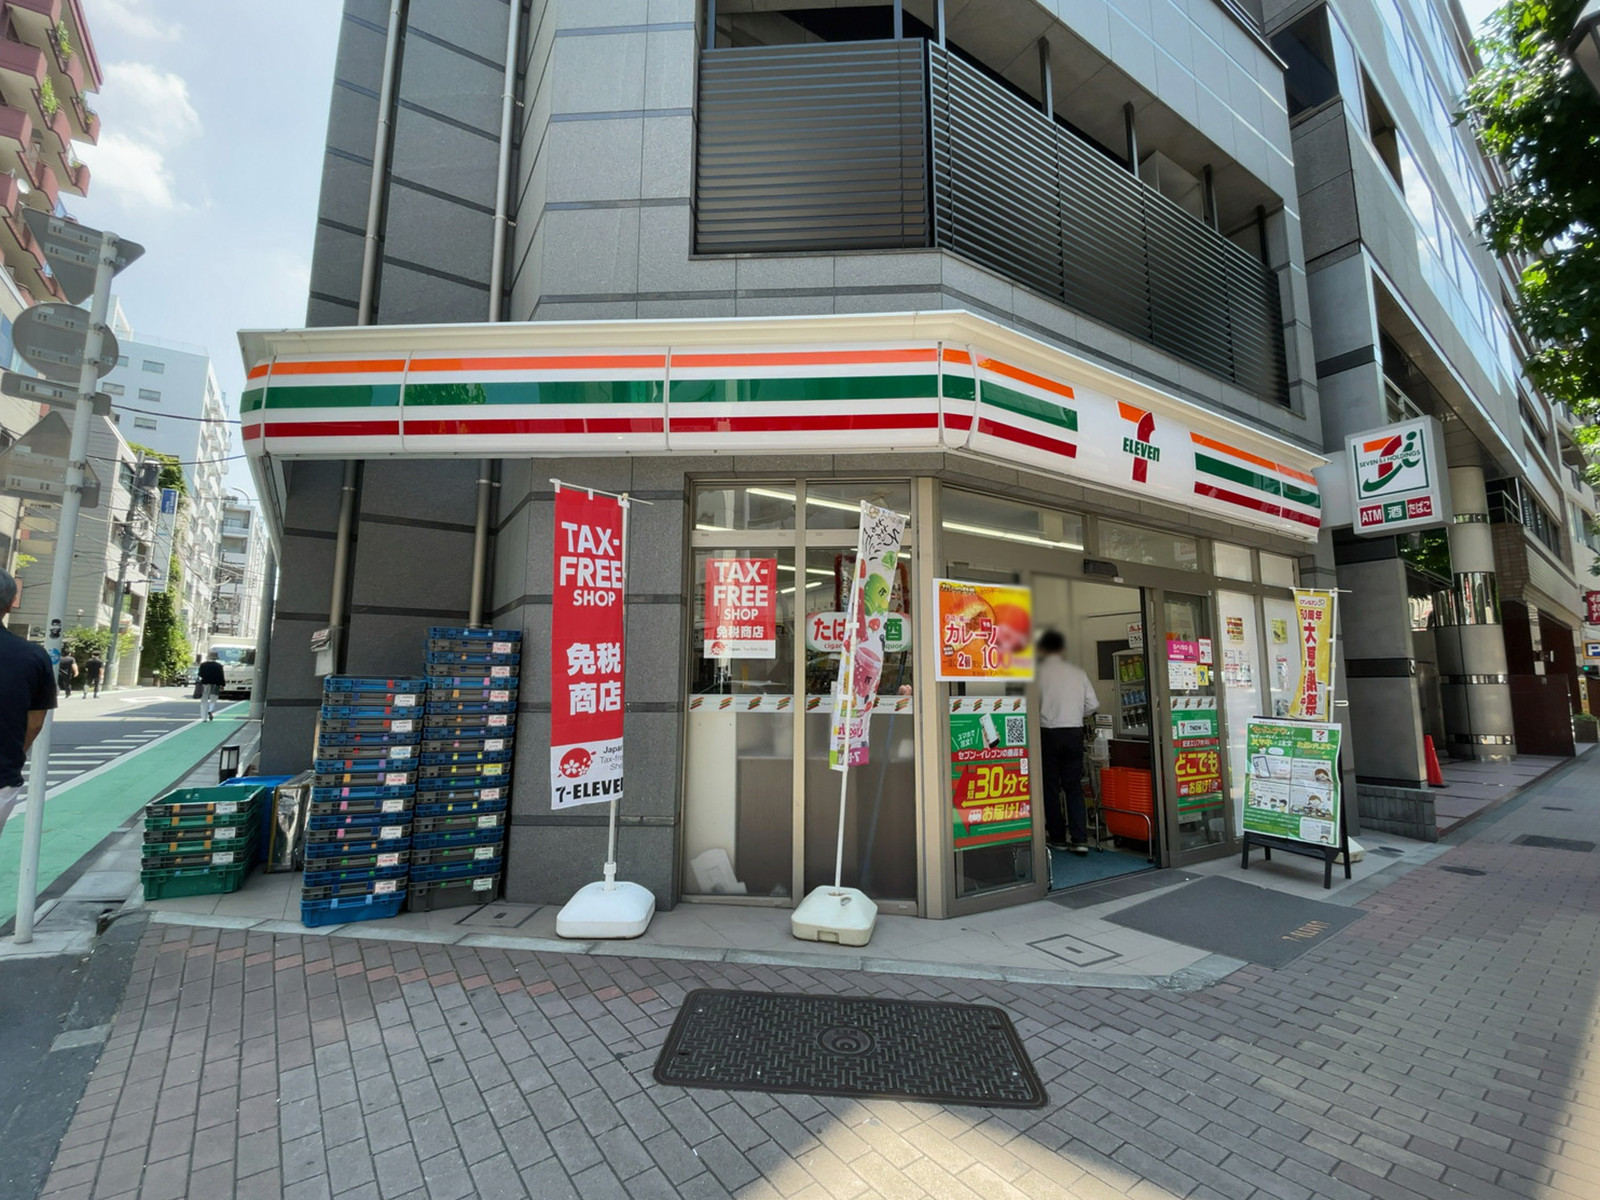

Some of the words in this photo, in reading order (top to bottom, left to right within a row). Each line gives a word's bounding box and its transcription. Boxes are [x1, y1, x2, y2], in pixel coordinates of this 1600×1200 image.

[1360, 458, 1379, 468] SEVEN
[1387, 449, 1421, 461] HOLDINGS
[1362, 508, 1382, 523] ATM
[1387, 505, 1402, 519] 酒
[1408, 501, 1431, 515] たばこ
[561, 521, 620, 557] TAX-
[560, 556, 622, 589] FREE
[714, 561, 768, 583] TAX-
[573, 589, 616, 607] SHOP
[713, 585, 768, 607] FREE
[724, 608, 759, 620] SHOP
[716, 625, 764, 638] 免税商店
[566, 643, 621, 676] 免税
[568, 680, 621, 716] 商店
[1175, 751, 1219, 775] どこでも
